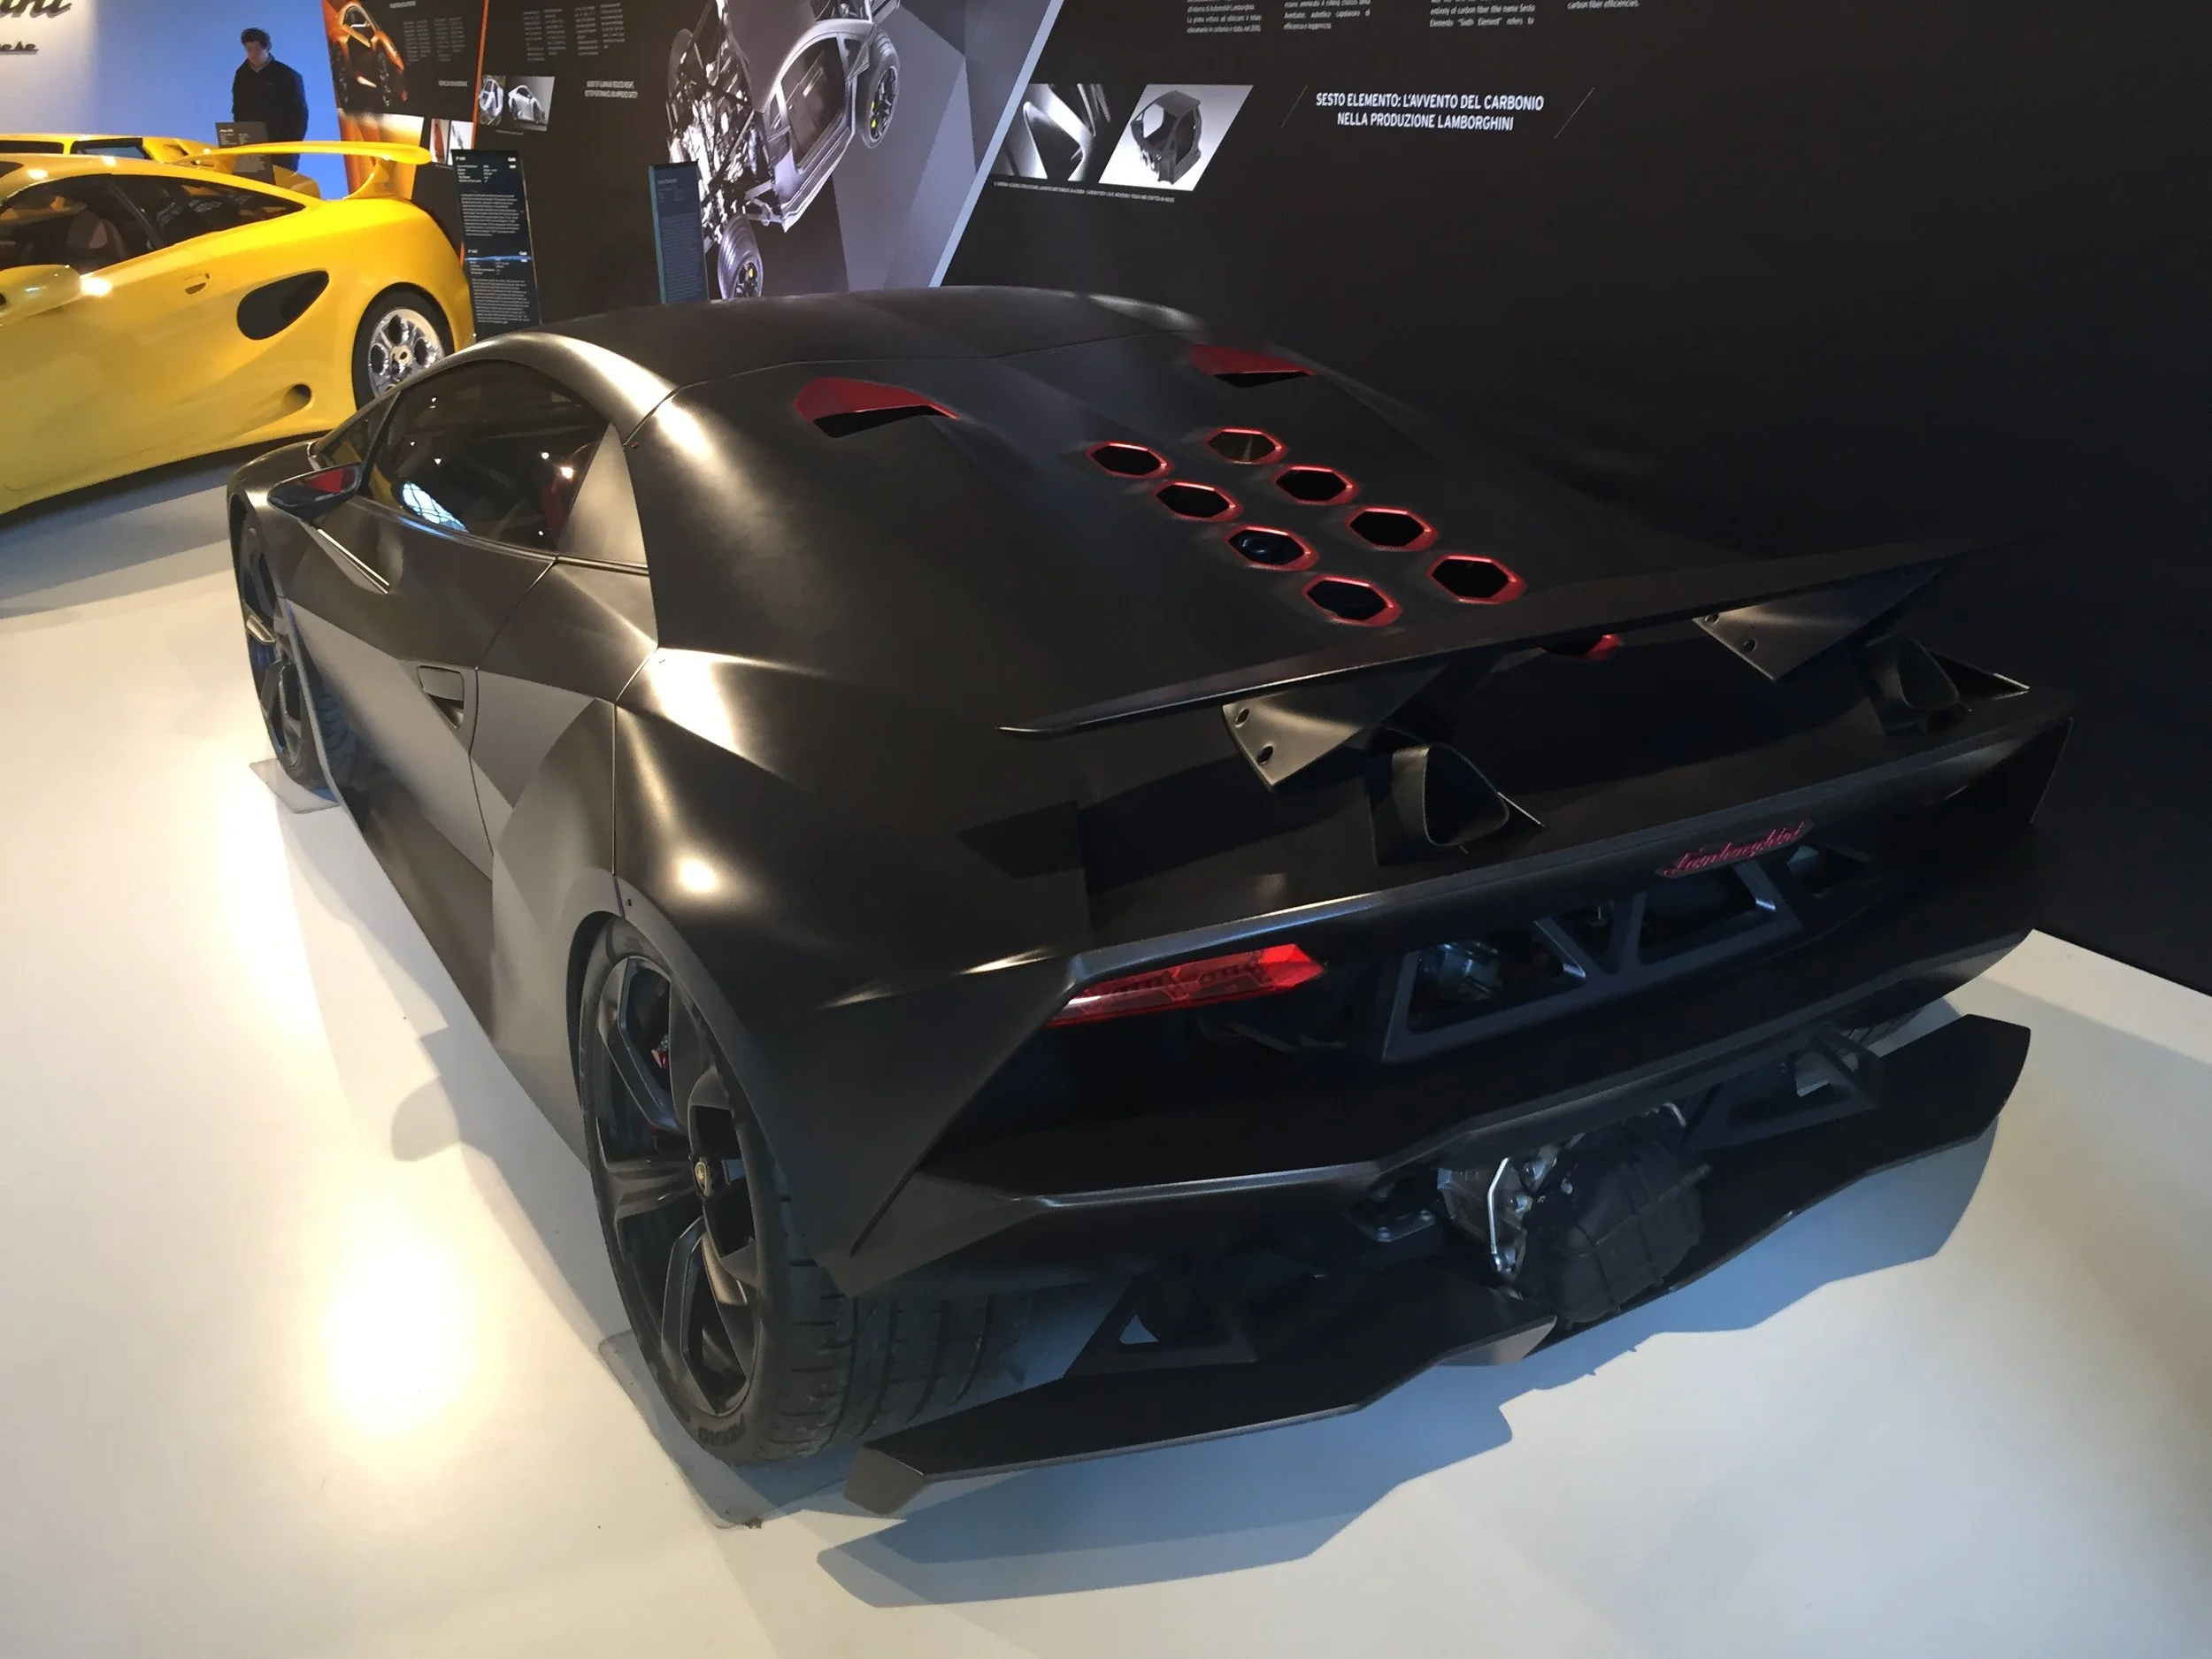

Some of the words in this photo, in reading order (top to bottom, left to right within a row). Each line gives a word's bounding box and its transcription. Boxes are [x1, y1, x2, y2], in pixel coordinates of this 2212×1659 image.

[1316, 92, 1346, 106] SESTO
[1347, 93, 1402, 108] ELEMENTO:
[1402, 94, 1458, 109] L'AVVENTO
[1460, 95, 1481, 109] DEL
[1484, 95, 1545, 111] CARBONIO
[1337, 111, 1368, 127] NELLA
[1370, 112, 1435, 128] PRODUZIONE
[1437, 114, 1514, 131] LAMBORGHINI
